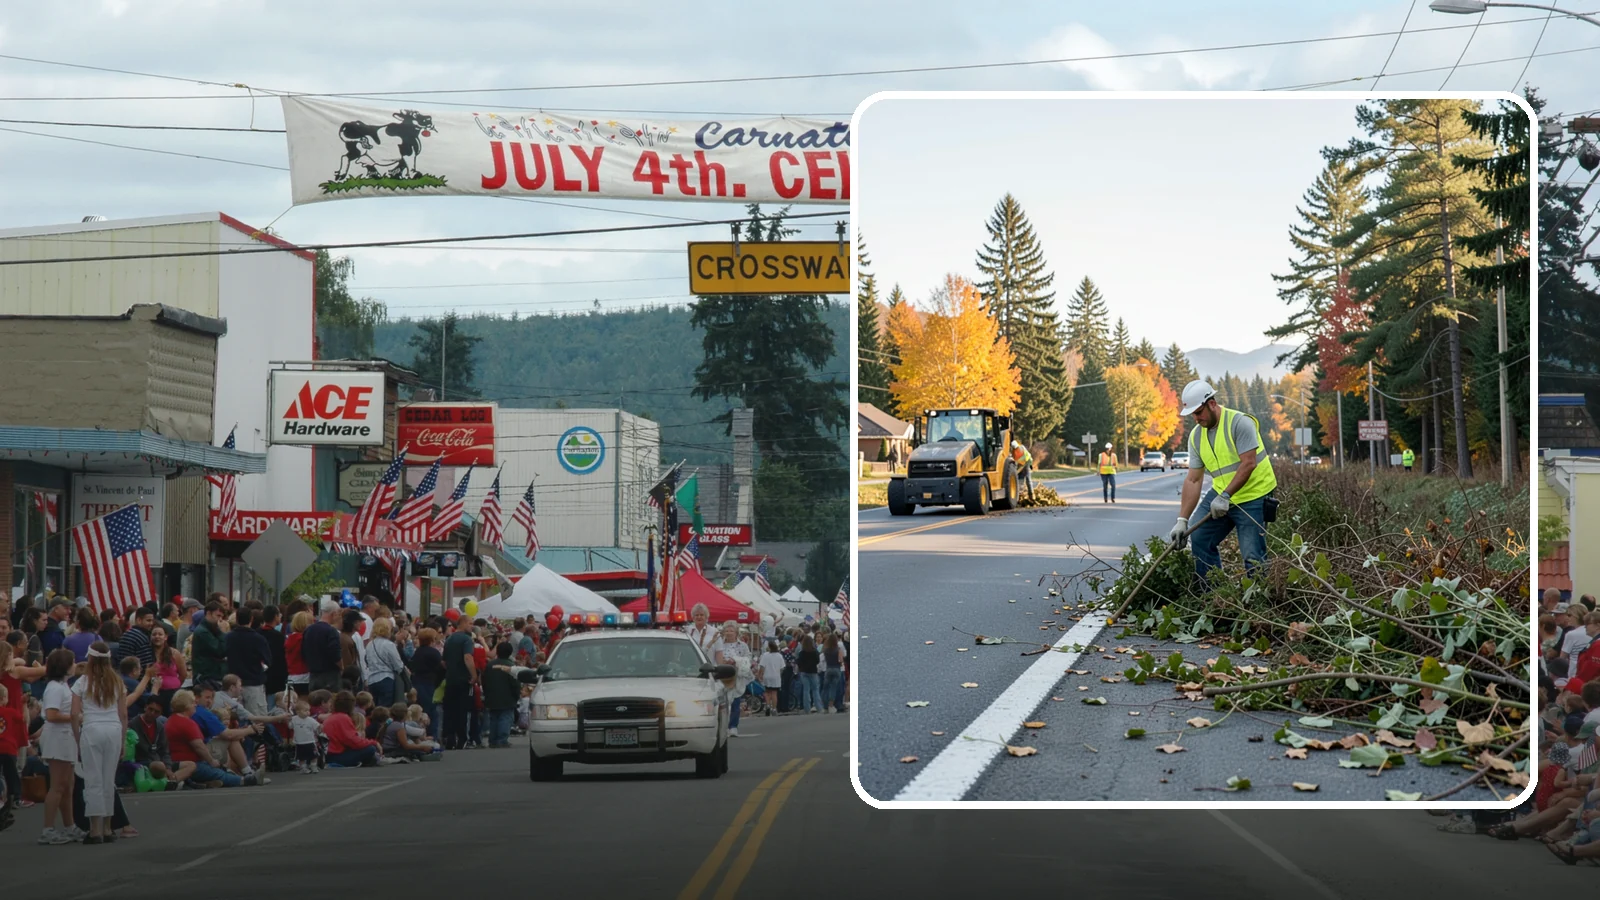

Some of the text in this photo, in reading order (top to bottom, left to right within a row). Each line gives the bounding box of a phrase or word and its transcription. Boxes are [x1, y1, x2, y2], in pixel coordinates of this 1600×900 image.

[695, 121, 850, 150] Carnat
[481, 141, 605, 193] JULY
[632, 149, 746, 198] 4th.
[696, 254, 850, 280] CROSSWA
[282, 379, 374, 420] ACE
[405, 409, 453, 422] CEDAR
[283, 420, 371, 437] Hardware
[416, 427, 477, 447] Coca-Cola
[96, 485, 124, 495] Vincent
[126, 486, 135, 495] de
[138, 486, 155, 495] Paul
[81, 503, 154, 522] THT
[688, 526, 741, 535] CRNATION
[699, 535, 730, 543] GLASS
